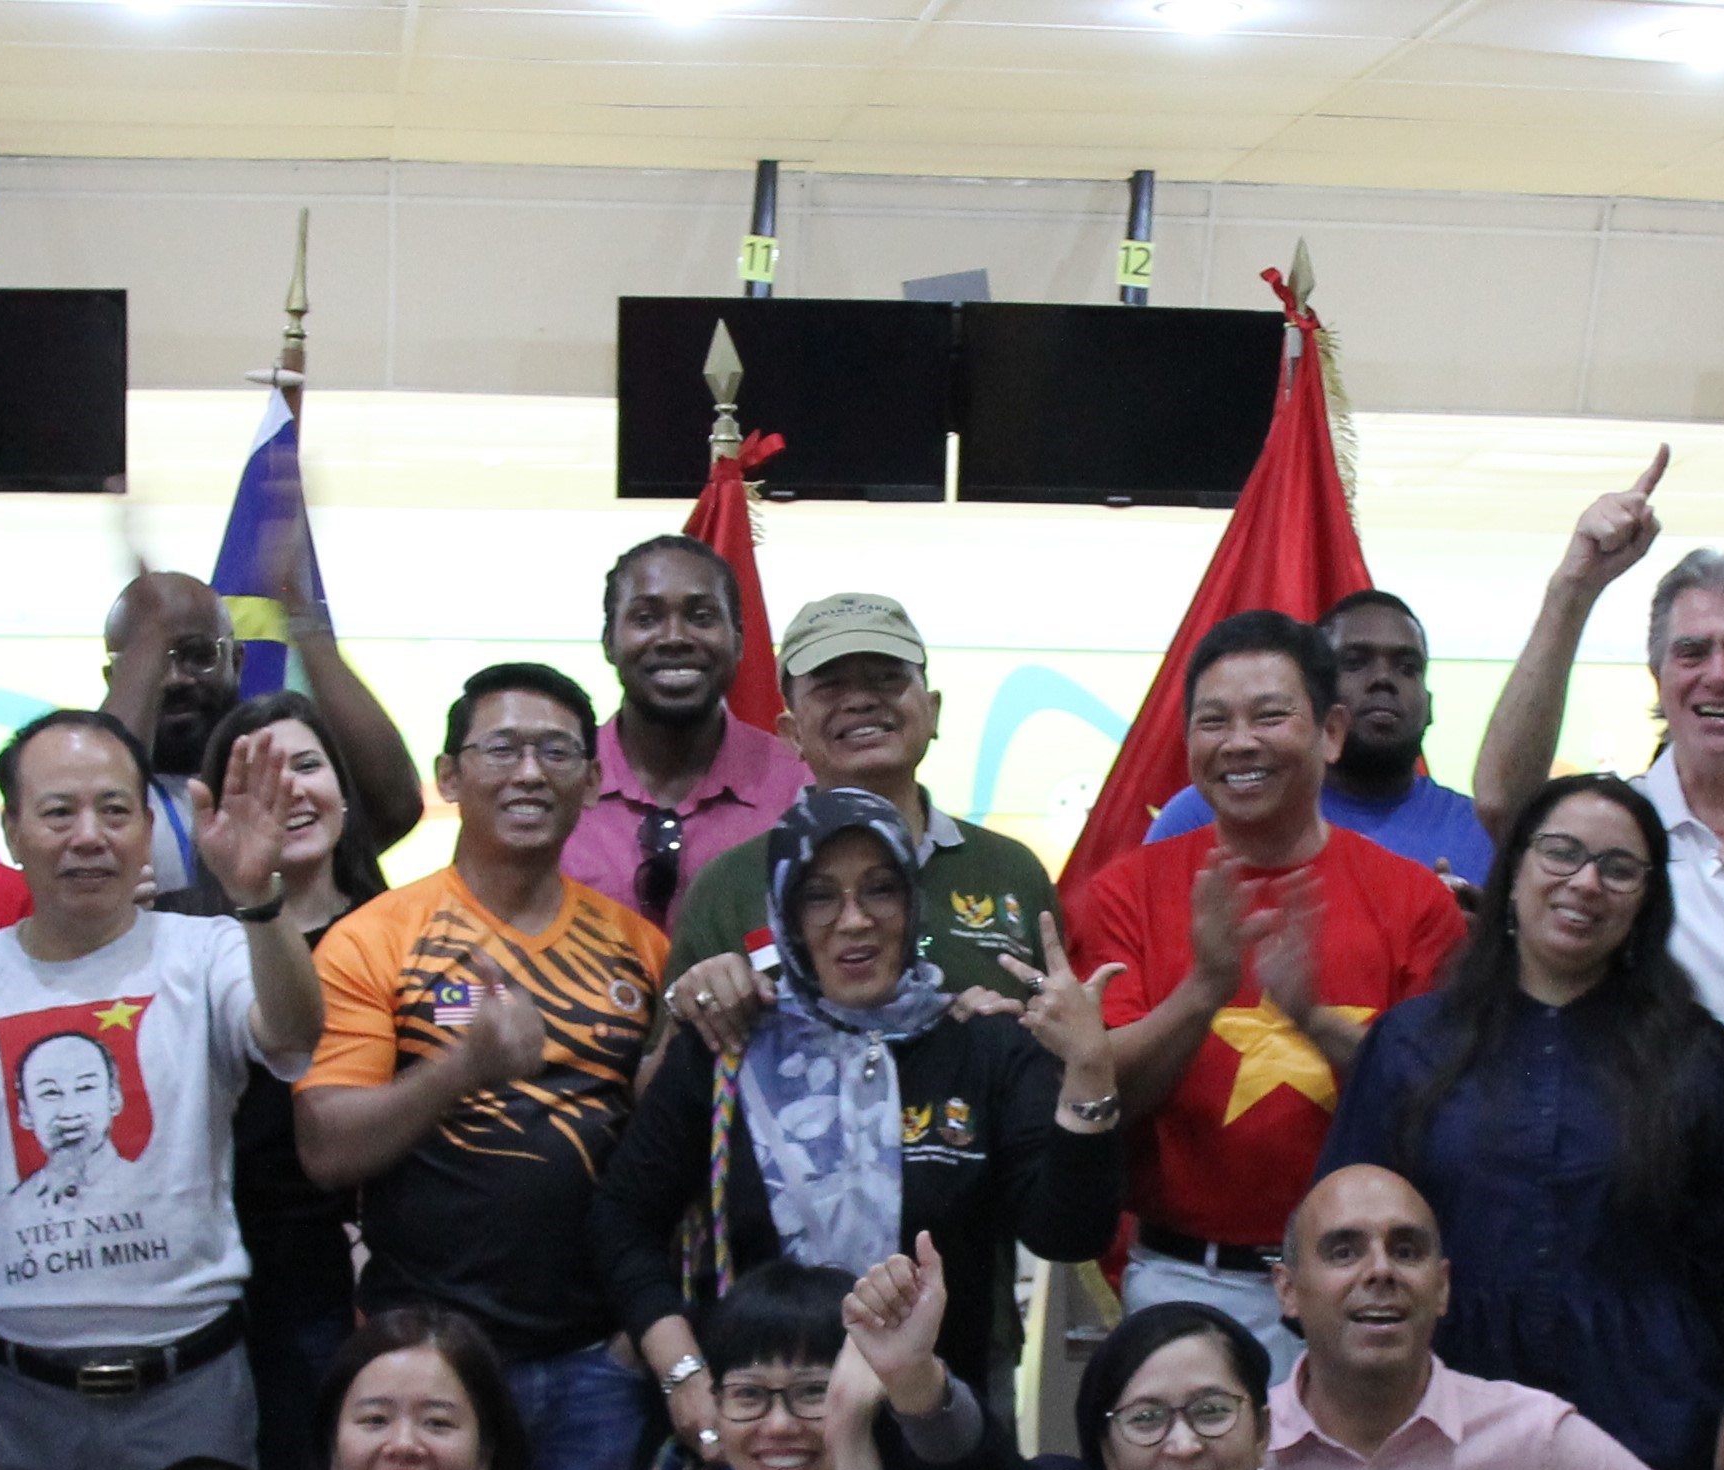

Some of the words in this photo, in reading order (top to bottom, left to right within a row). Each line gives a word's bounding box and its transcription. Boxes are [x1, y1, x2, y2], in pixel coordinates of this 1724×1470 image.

[744, 240, 772, 272] 11
[1120, 245, 1152, 278] 12
[84, 1212, 144, 1237] NAM
[100, 1238, 169, 1268] MINH
